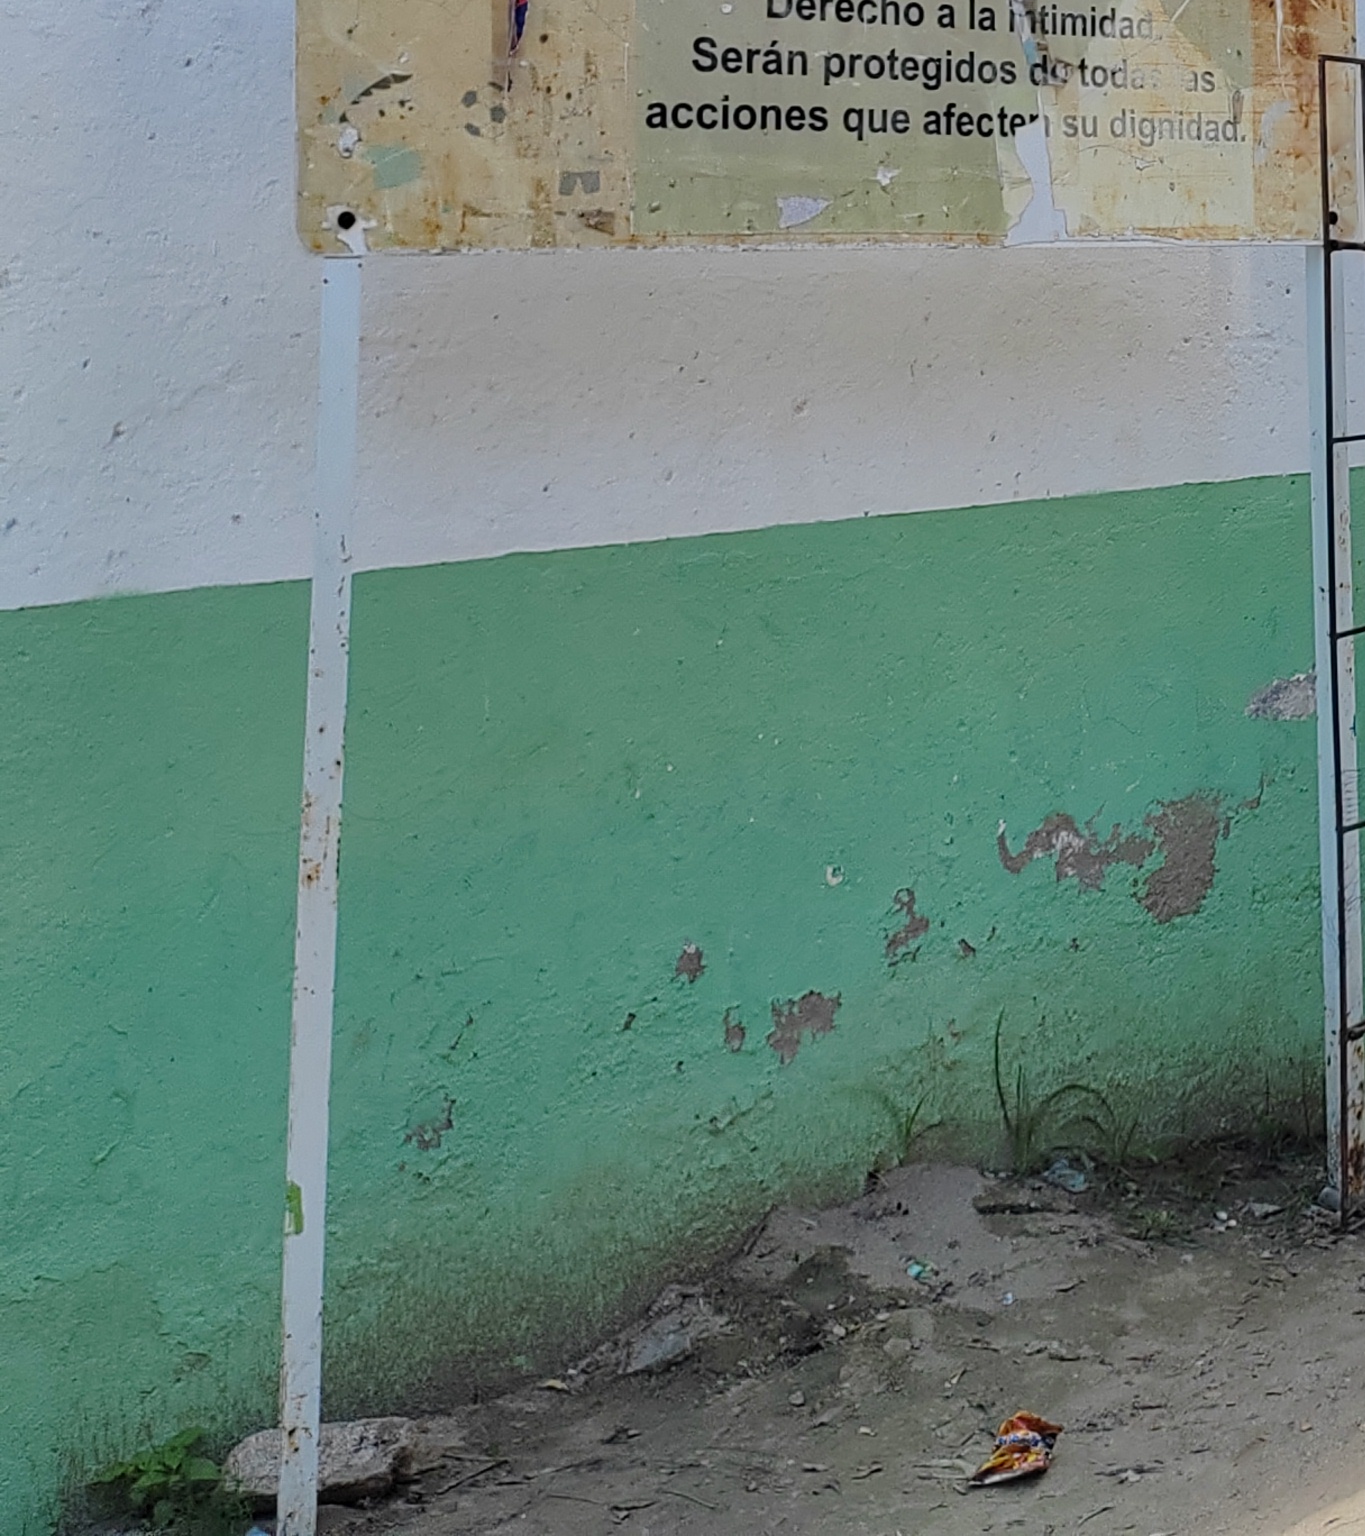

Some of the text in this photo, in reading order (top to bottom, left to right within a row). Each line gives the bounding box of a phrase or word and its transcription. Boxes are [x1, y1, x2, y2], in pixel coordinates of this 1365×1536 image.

[937, 2, 955, 28] a
[691, 36, 808, 75] Serán
[823, 48, 1017, 91] protegidos
[645, 95, 829, 132] acciones
[843, 106, 911, 141] que
[1062, 114, 1098, 138] su
[1110, 109, 1246, 147] dignidad.
